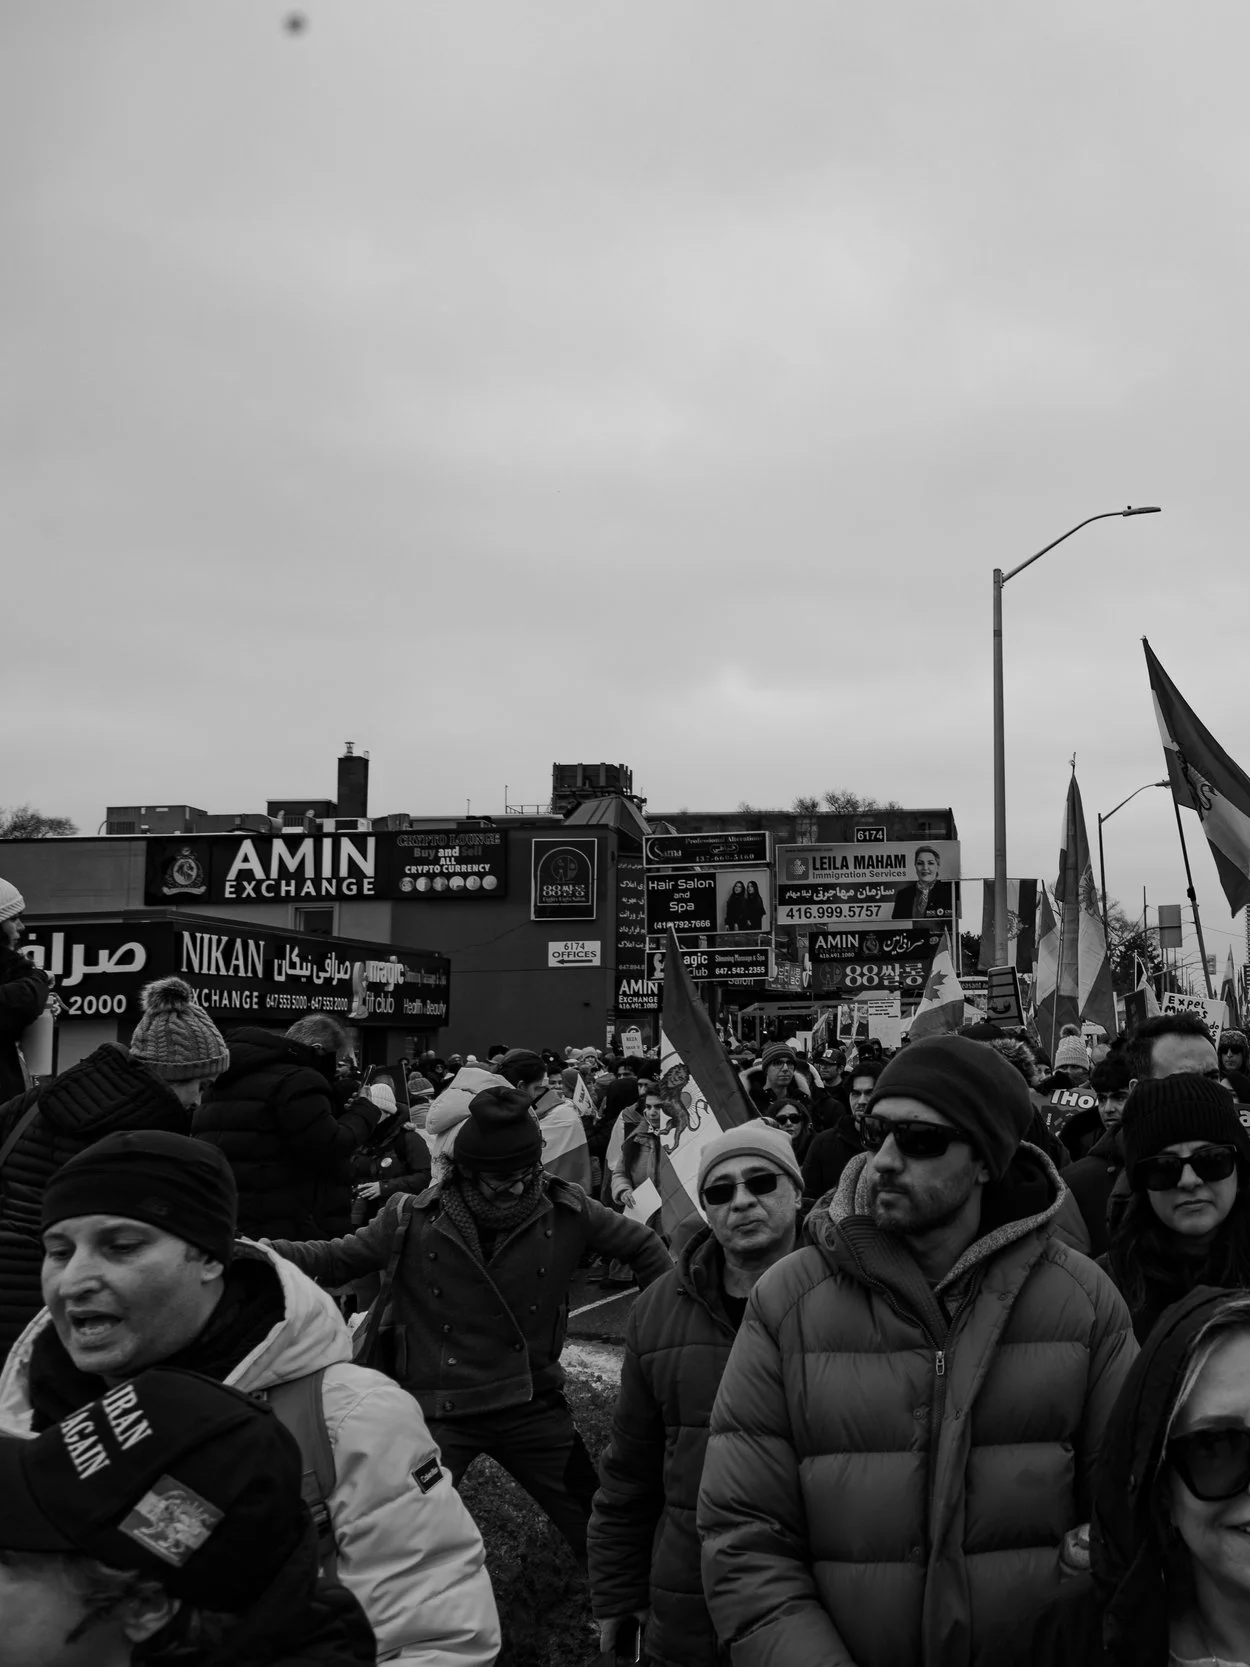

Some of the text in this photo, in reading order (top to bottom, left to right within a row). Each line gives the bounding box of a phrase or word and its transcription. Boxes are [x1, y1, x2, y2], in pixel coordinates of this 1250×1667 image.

[857, 830, 884, 840] 6174
[225, 836, 377, 881] AMIN
[413, 847, 436, 860] Buy
[437, 845, 460, 857] and
[439, 857, 456, 865] ALL
[812, 854, 907, 871] LEILA MAHAM
[404, 863, 491, 875] CRYPTO CURRENCY
[812, 869, 907, 881] Immigration Services
[224, 878, 376, 898] EXCHANGE
[649, 880, 674, 891] Hair
[677, 878, 715, 889] Salon
[672, 891, 690, 900] and
[812, 886, 856, 901] مهاجرتی
[857, 886, 896, 900] سازمان
[669, 901, 695, 914] Spa
[785, 904, 883, 920] 416.999.5757
[563, 942, 585, 951] 6174
[814, 933, 860, 949] AMIN
[180, 930, 265, 980] NIKAN
[551, 950, 597, 959] OFFICES
[682, 953, 709, 967] agic
[273, 944, 352, 986] صرافی نیکان
[714, 966, 766, 976] 647.542.2355
[619, 979, 658, 995] AMIN
[68, 994, 128, 1016] 2000
[191, 987, 260, 1010] XCHANGE
[265, 994, 279, 1009] 647
[311, 996, 322, 1011] 647
[375, 992, 395, 1013] club
[403, 998, 423, 1015] Health
[426, 999, 447, 1019] Beauty
[618, 995, 659, 1003] EXCHANGE
[1168, 995, 1206, 1009] Expel
